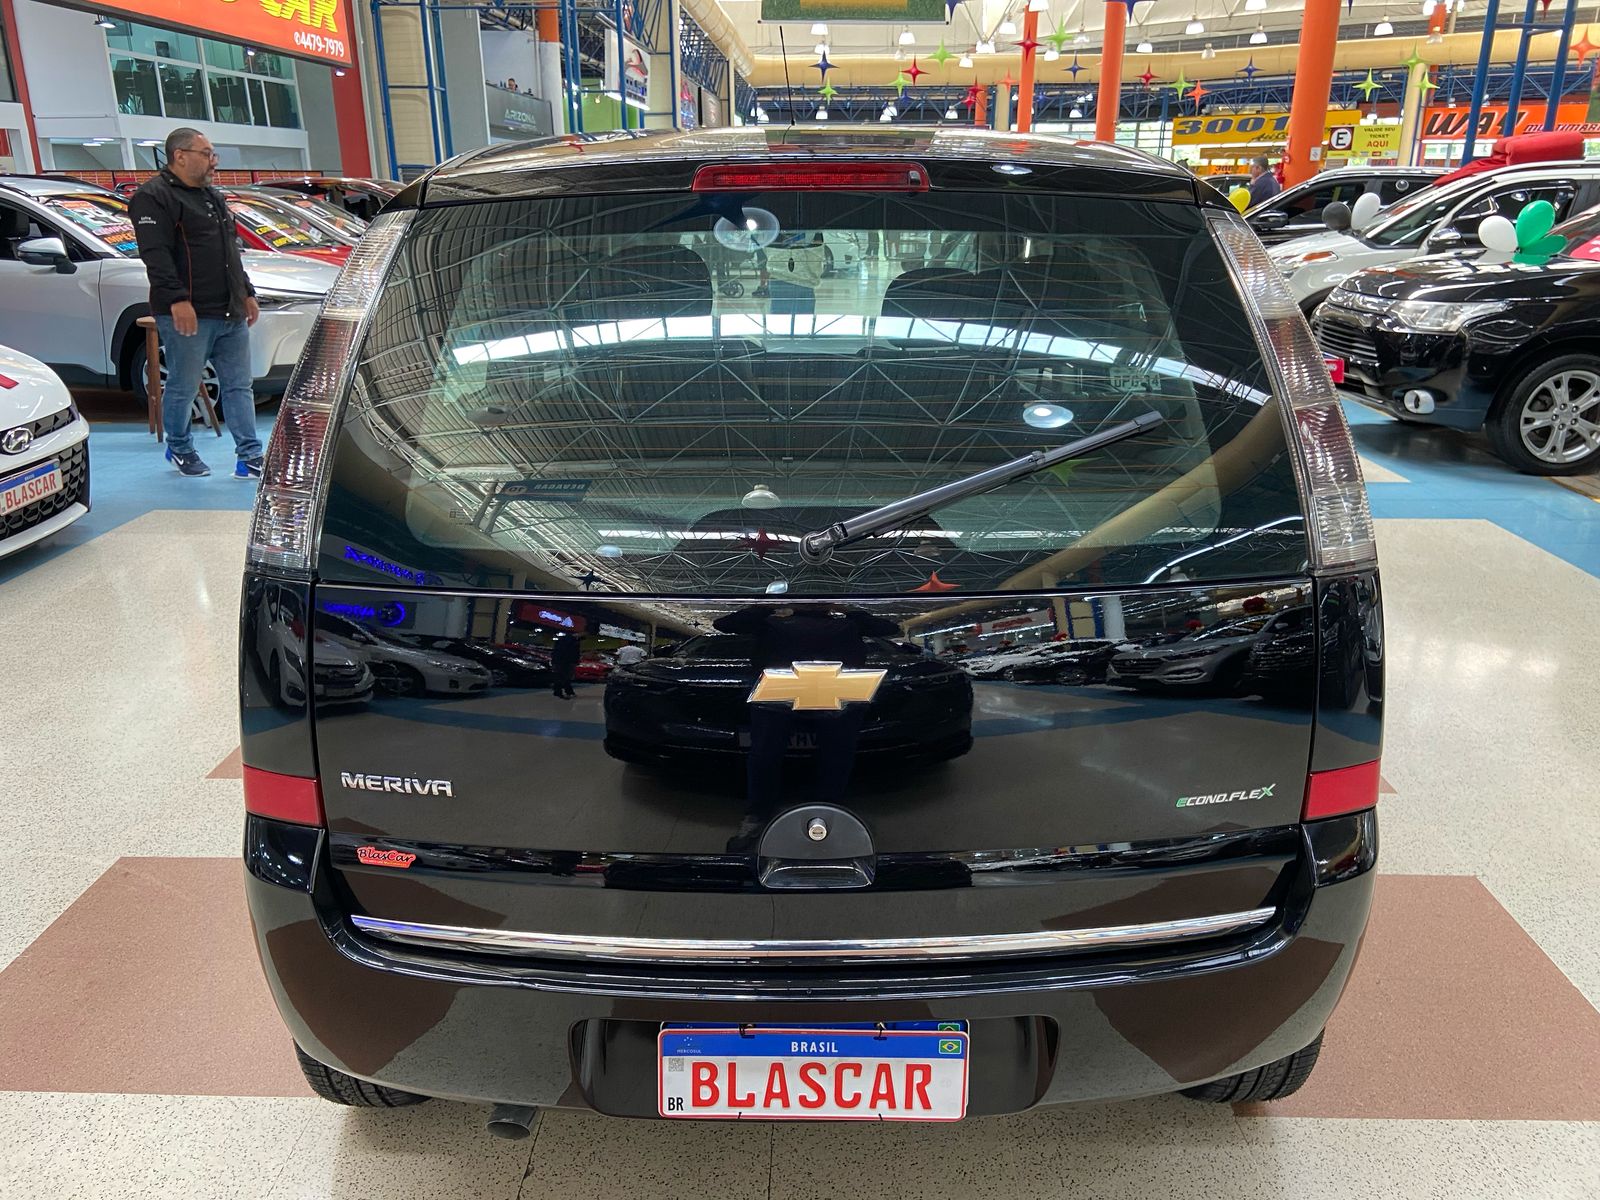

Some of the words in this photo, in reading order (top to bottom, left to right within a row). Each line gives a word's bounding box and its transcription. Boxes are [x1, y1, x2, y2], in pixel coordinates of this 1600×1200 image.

[300, 31, 345, 57] 4479-7979
[504, 108, 536, 124] ARIZONA
[1176, 116, 1290, 135] 3001
[1335, 132, 1348, 146] E
[5, 473, 56, 509] BLASCAR
[341, 772, 453, 797] MERIVA
[358, 848, 414, 862] BlasCar
[791, 1041, 838, 1053] BRASIL
[691, 1061, 933, 1110] BLASCAR
[667, 1096, 684, 1112] BR
